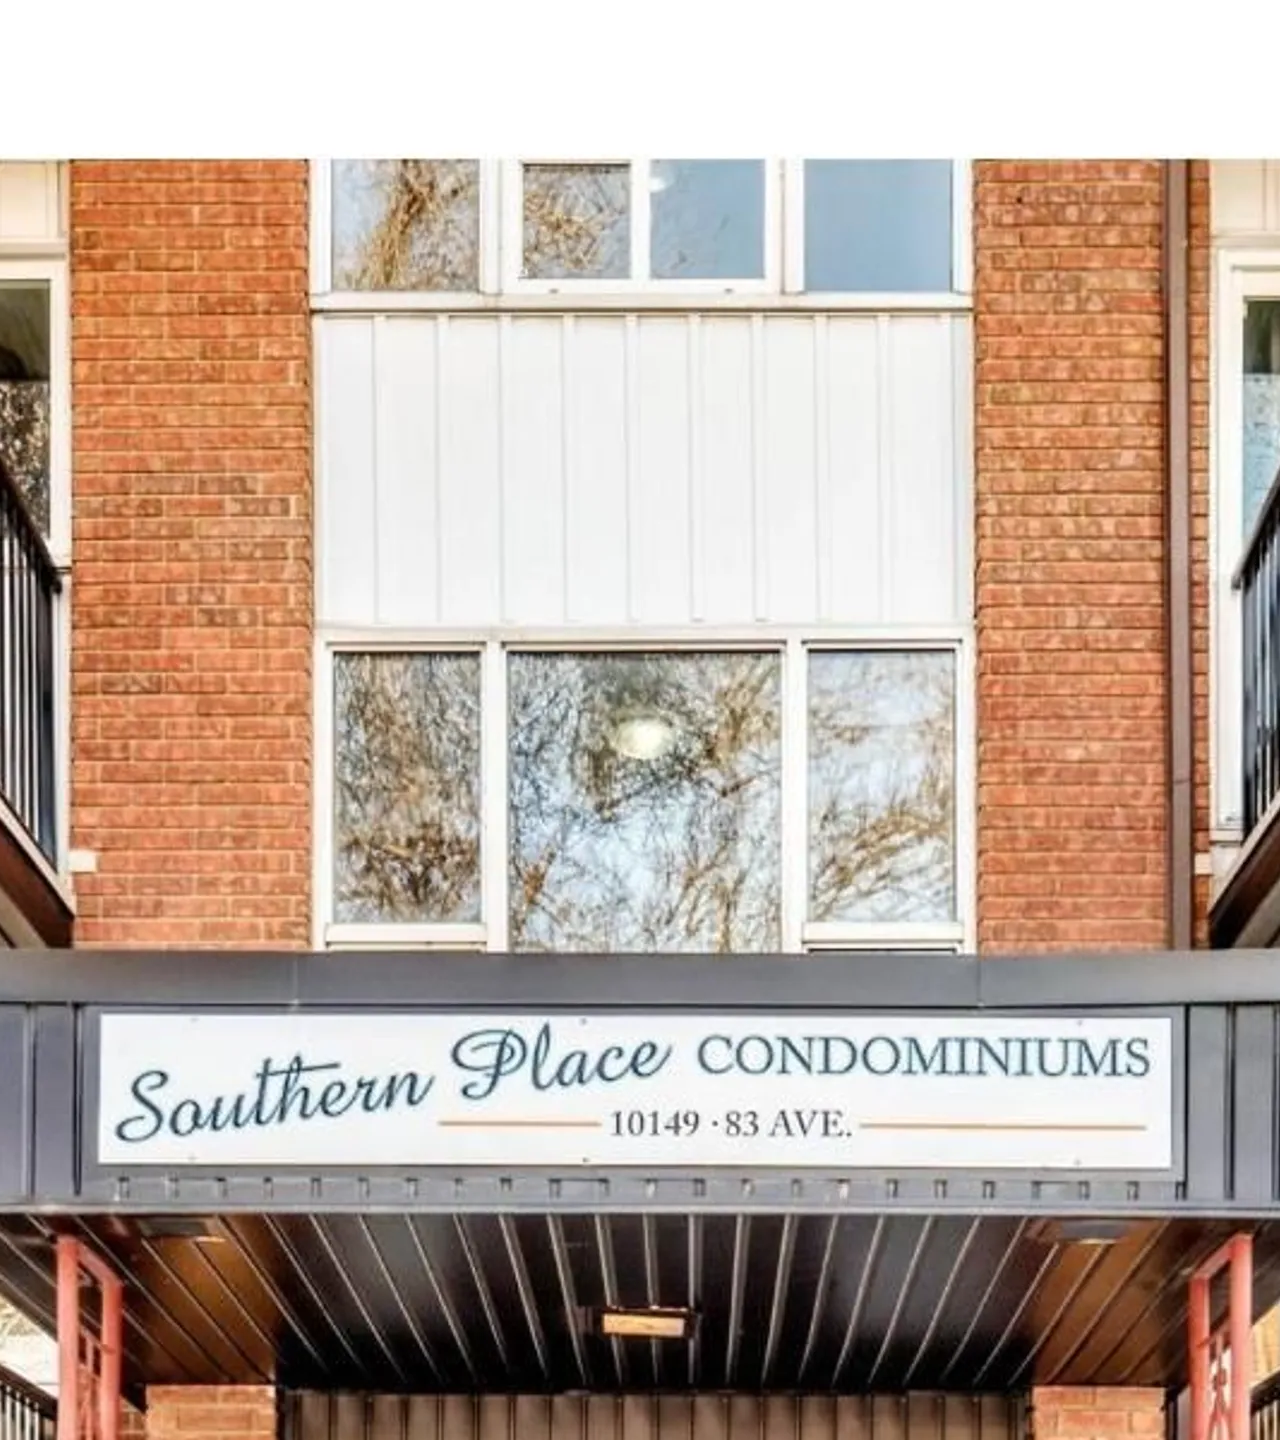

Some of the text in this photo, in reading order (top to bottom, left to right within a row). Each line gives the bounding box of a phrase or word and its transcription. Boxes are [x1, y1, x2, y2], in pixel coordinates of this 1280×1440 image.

[114, 1022, 1151, 1143] Southern Place CONDOMINIUMS
[609, 1109, 700, 1137] 10149
[725, 1109, 760, 1137] 83
[768, 1109, 853, 1138] AVE.
